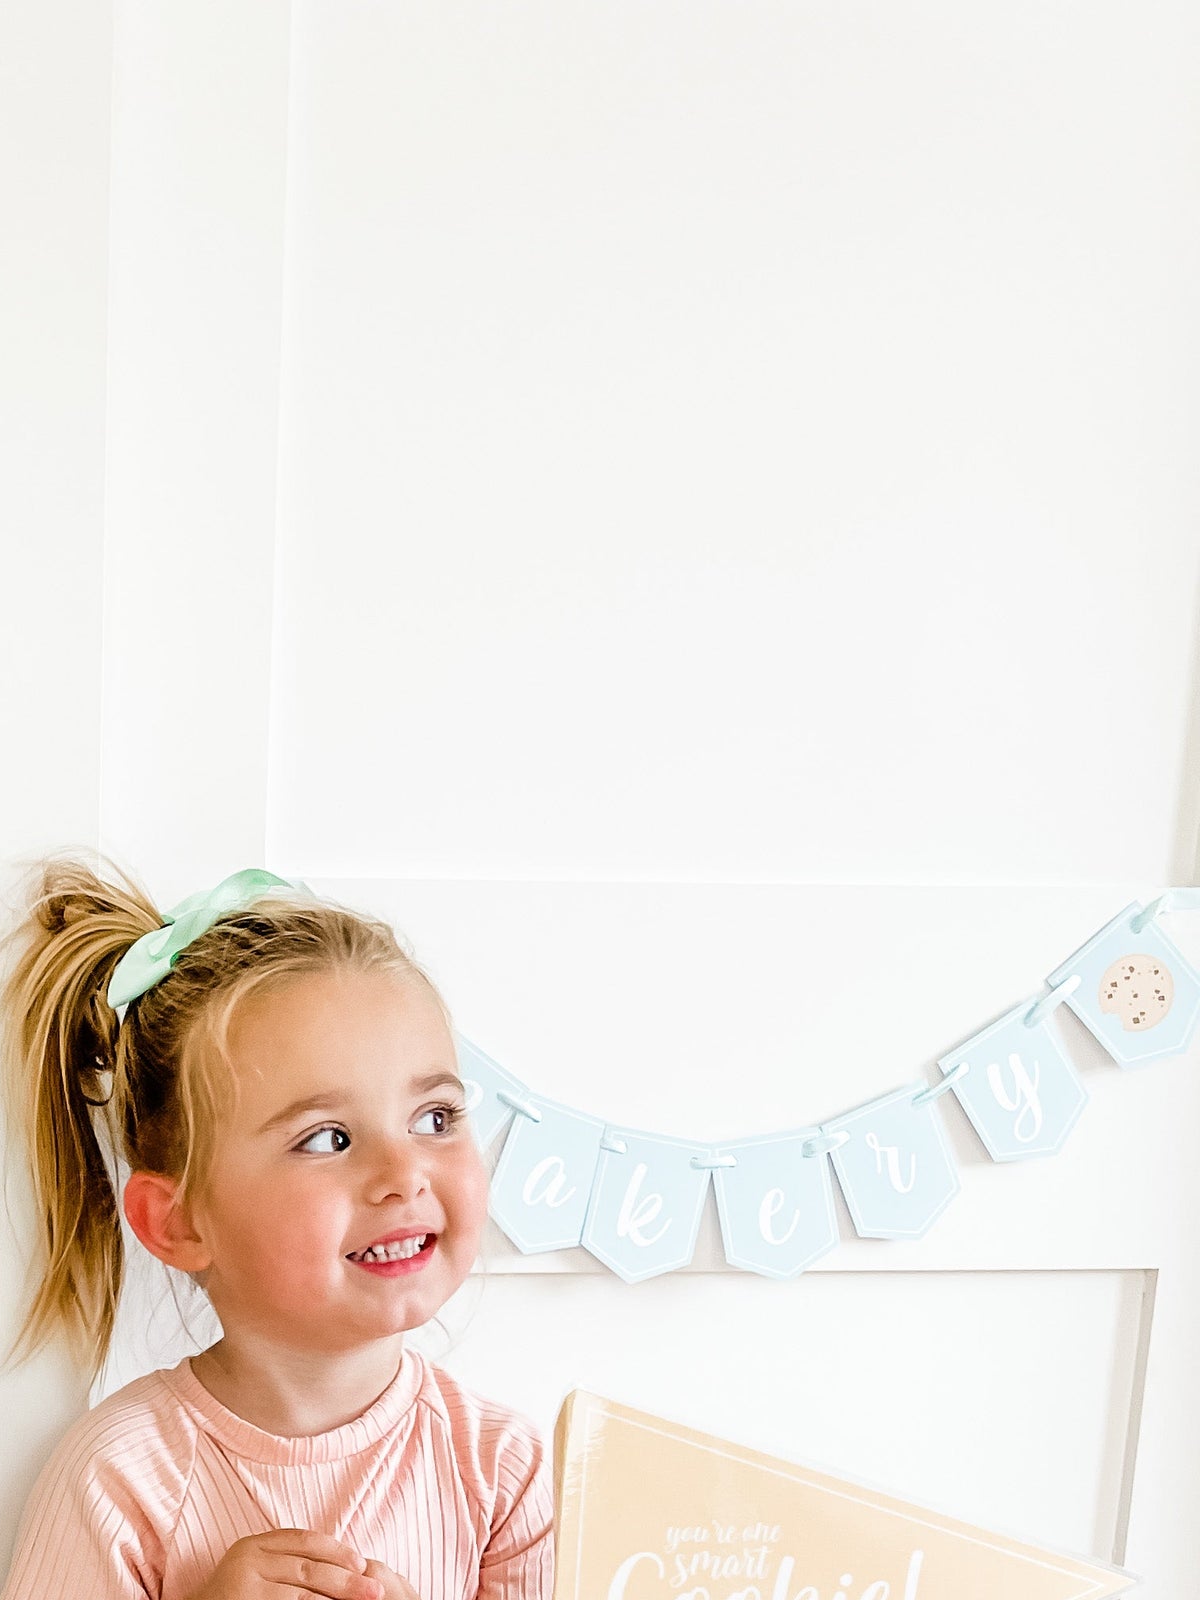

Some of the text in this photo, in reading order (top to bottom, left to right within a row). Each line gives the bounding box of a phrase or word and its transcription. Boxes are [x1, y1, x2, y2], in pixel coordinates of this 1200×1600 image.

[665, 1520, 781, 1553] you're one
[669, 1545, 773, 1588] smart
